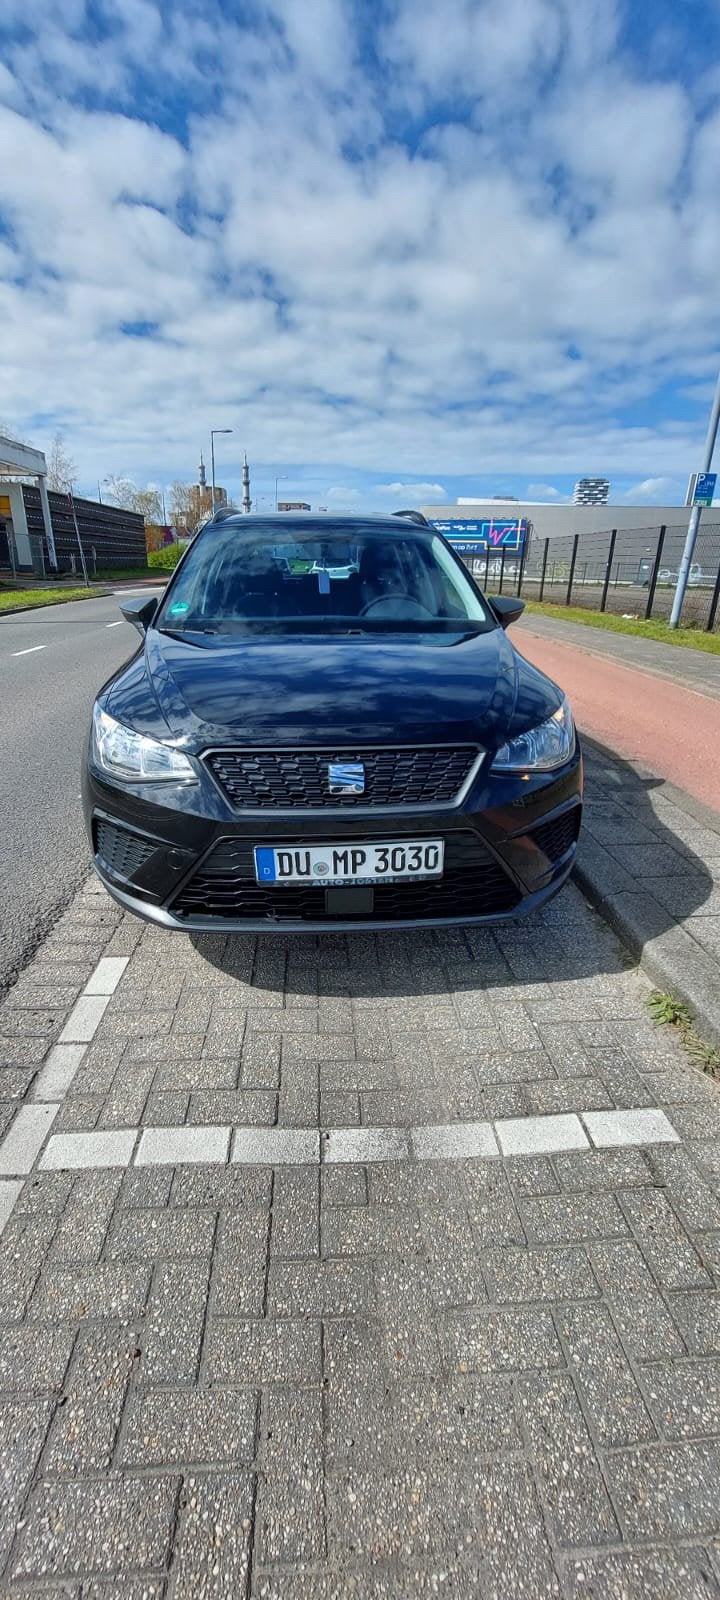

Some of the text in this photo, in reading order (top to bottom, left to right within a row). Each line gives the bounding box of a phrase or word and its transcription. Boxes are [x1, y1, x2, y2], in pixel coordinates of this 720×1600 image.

[263, 867, 271, 875] D
[277, 845, 439, 877] DU MP 3030
